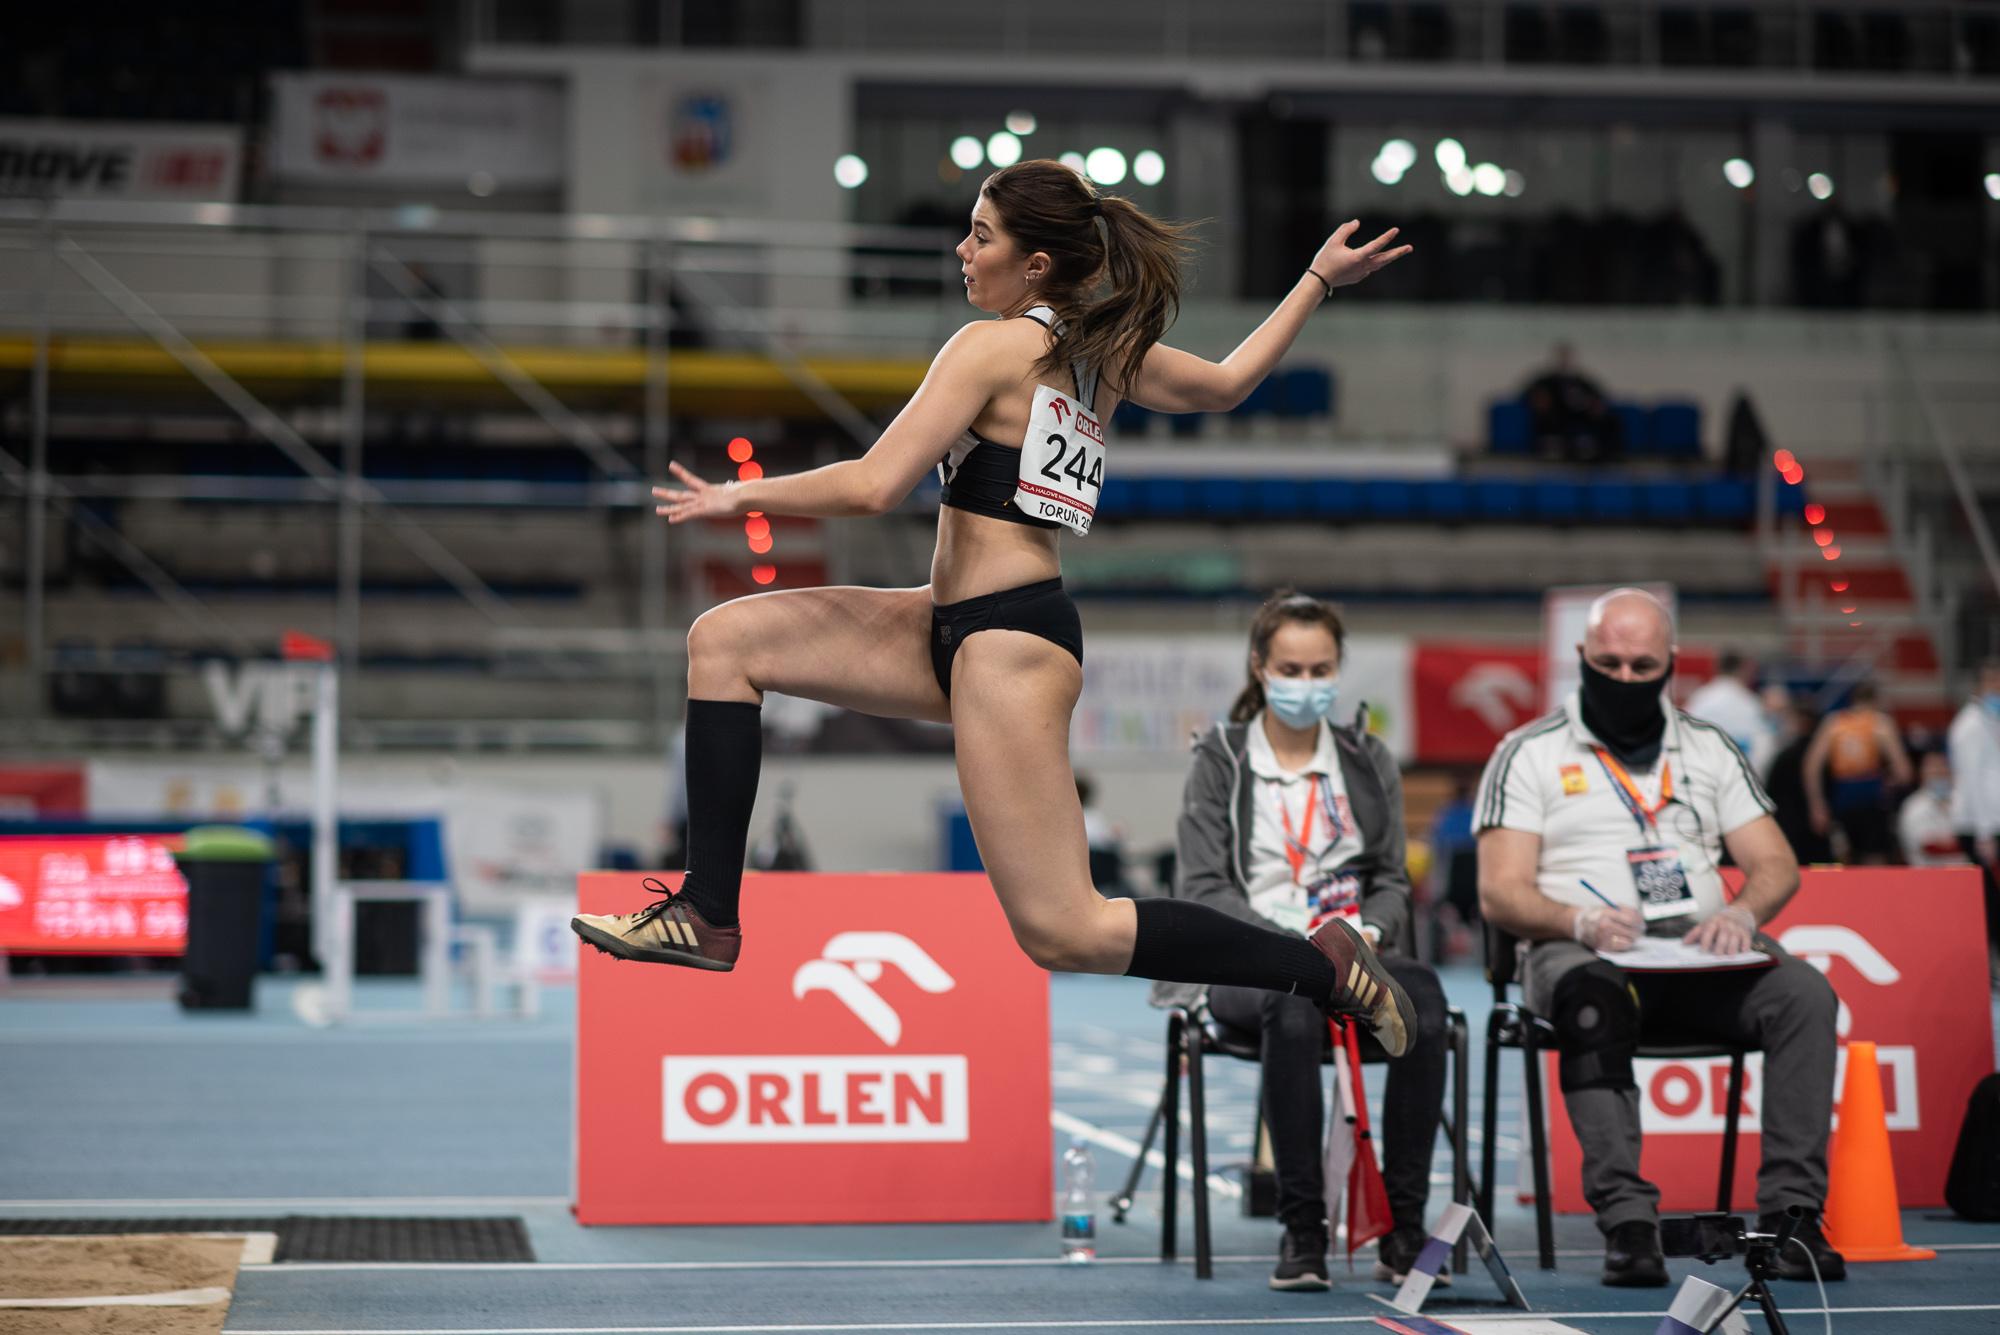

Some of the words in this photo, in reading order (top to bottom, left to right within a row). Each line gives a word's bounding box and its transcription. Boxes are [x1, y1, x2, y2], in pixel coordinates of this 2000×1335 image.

[1041, 434, 1102, 500] 244
[1035, 488, 1058, 499] HALOWE
[1039, 501, 1079, 526] TORUŃ
[682, 1071, 945, 1127] ORLEN
